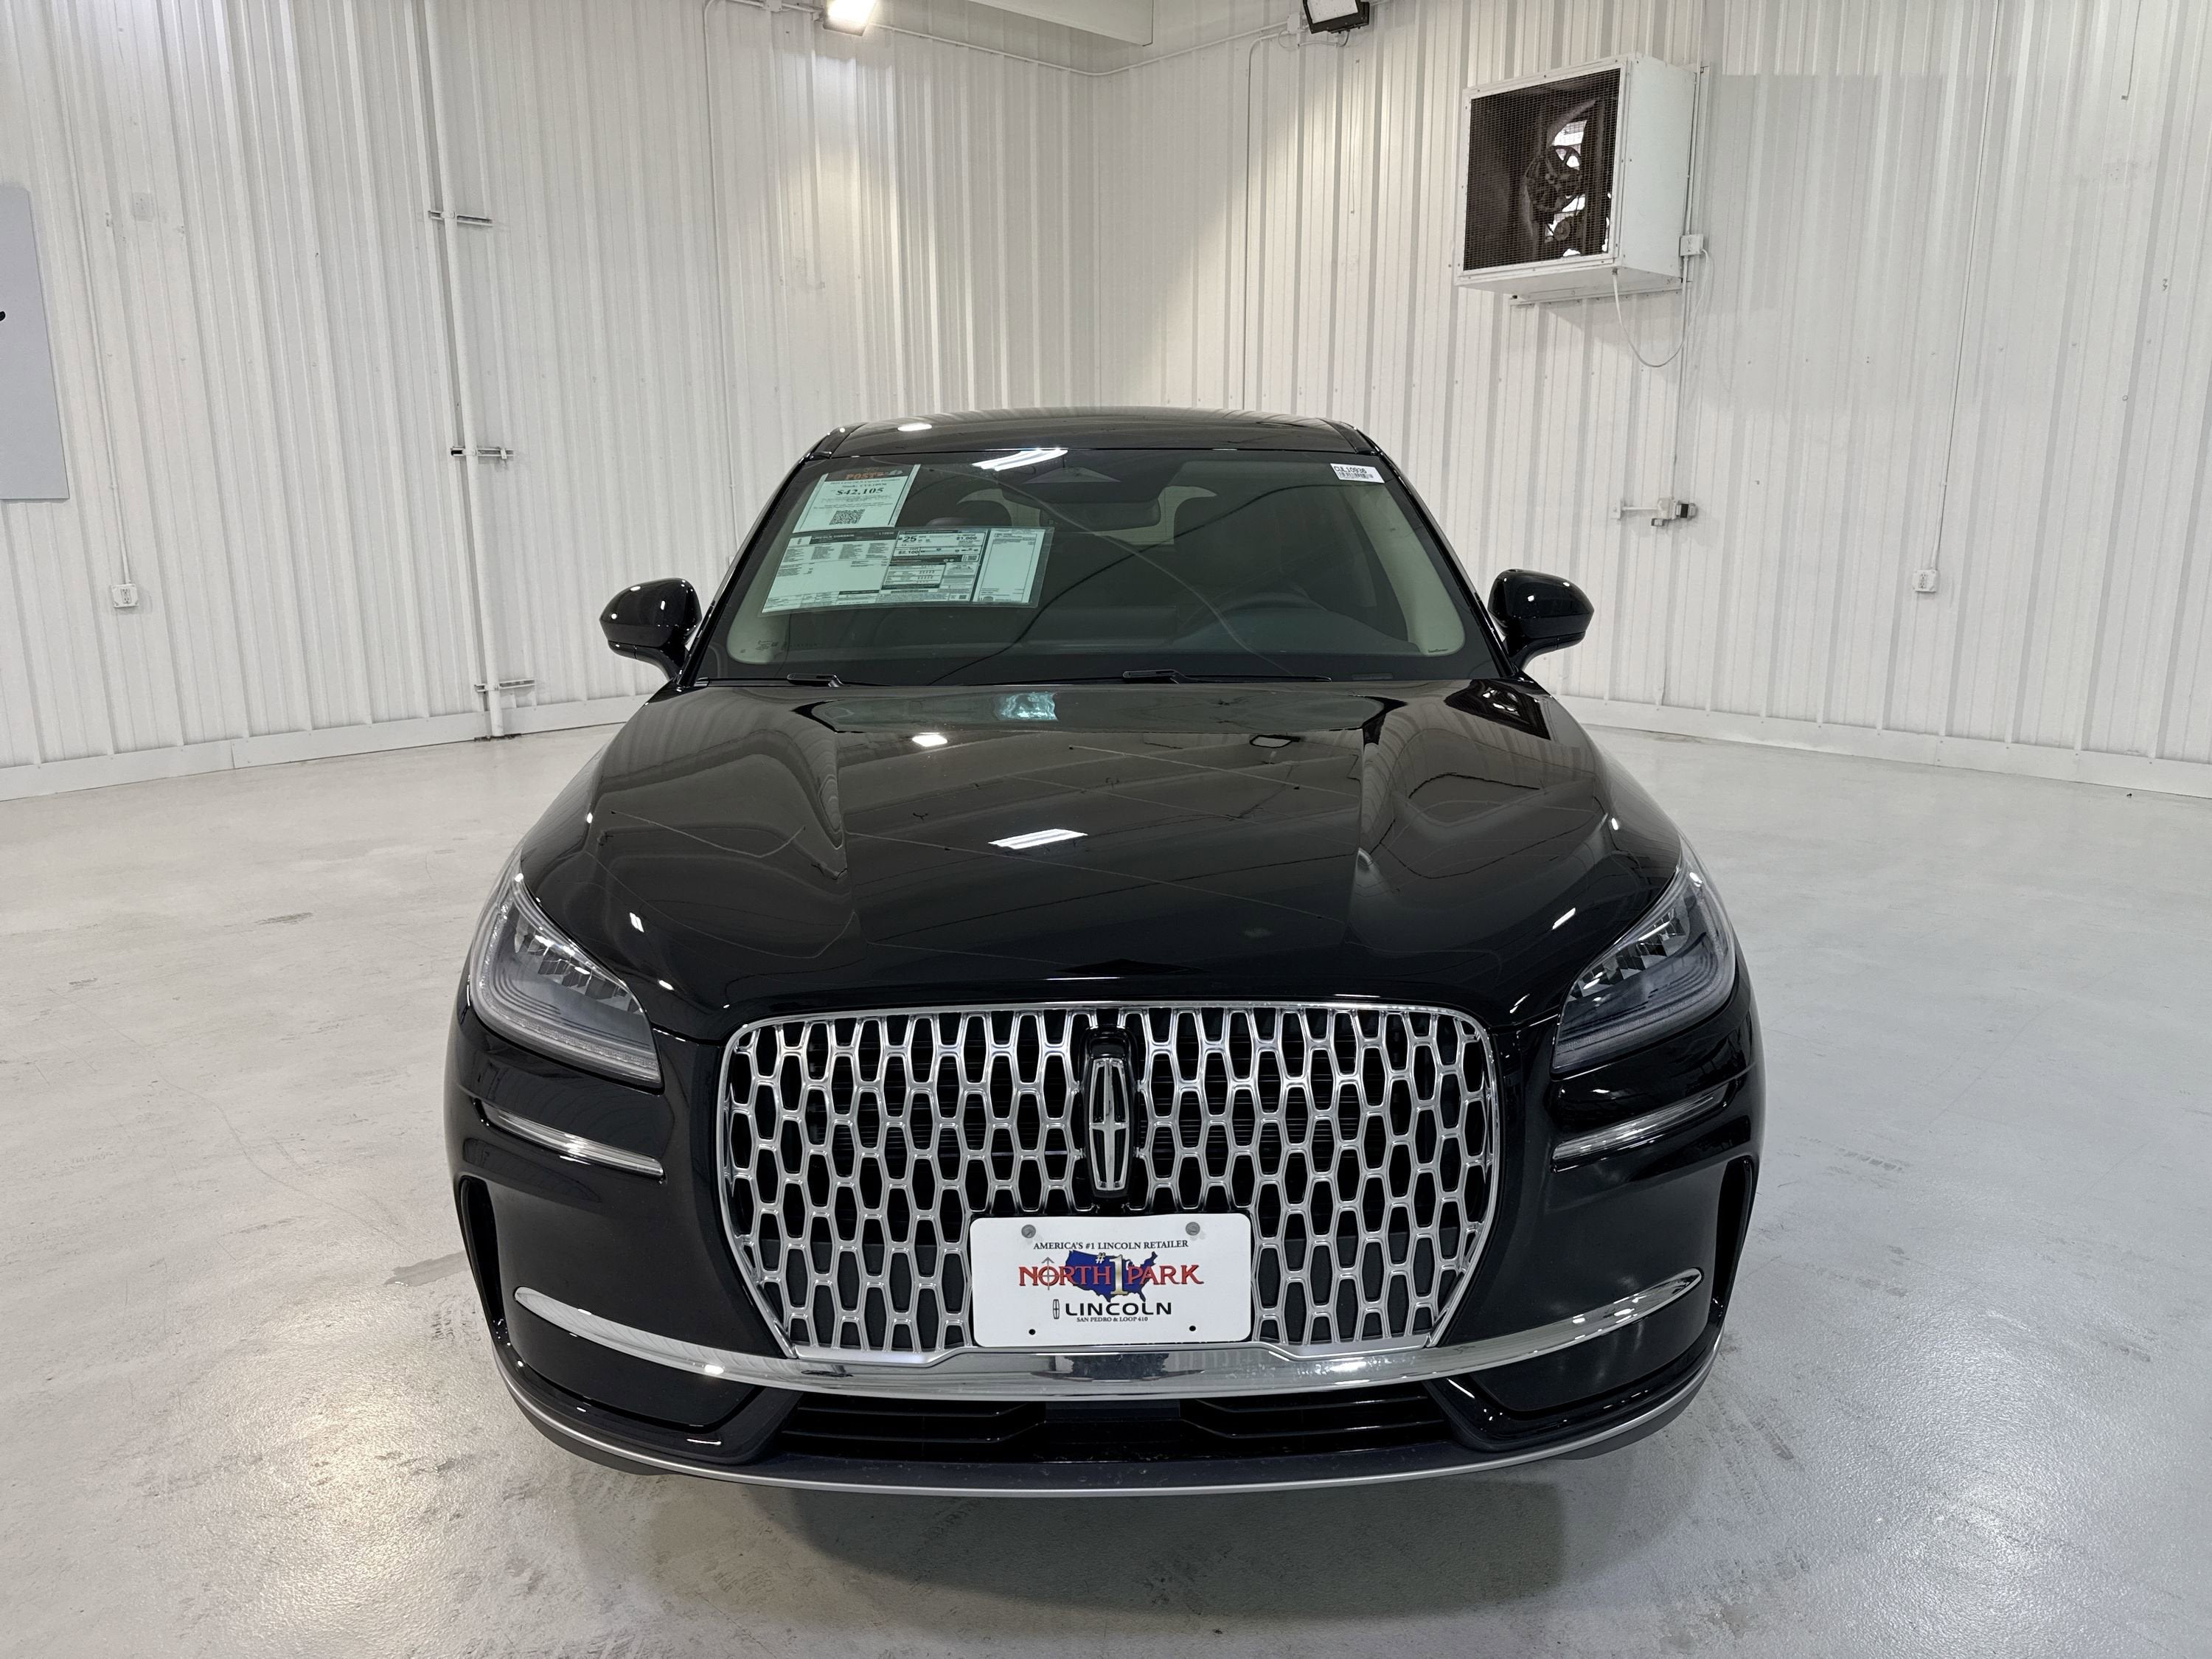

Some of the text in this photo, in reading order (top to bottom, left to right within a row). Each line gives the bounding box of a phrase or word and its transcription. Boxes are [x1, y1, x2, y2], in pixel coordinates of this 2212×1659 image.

[836, 487, 884, 495] $42,105
[1033, 1242, 1083, 1250] AMERICA'S
[1097, 1242, 1141, 1250] LINCOLN
[1144, 1239, 1189, 1249] RETAILER
[1018, 1265, 1205, 1286] NORTH PARK
[1065, 1302, 1172, 1316] LINCOLN
